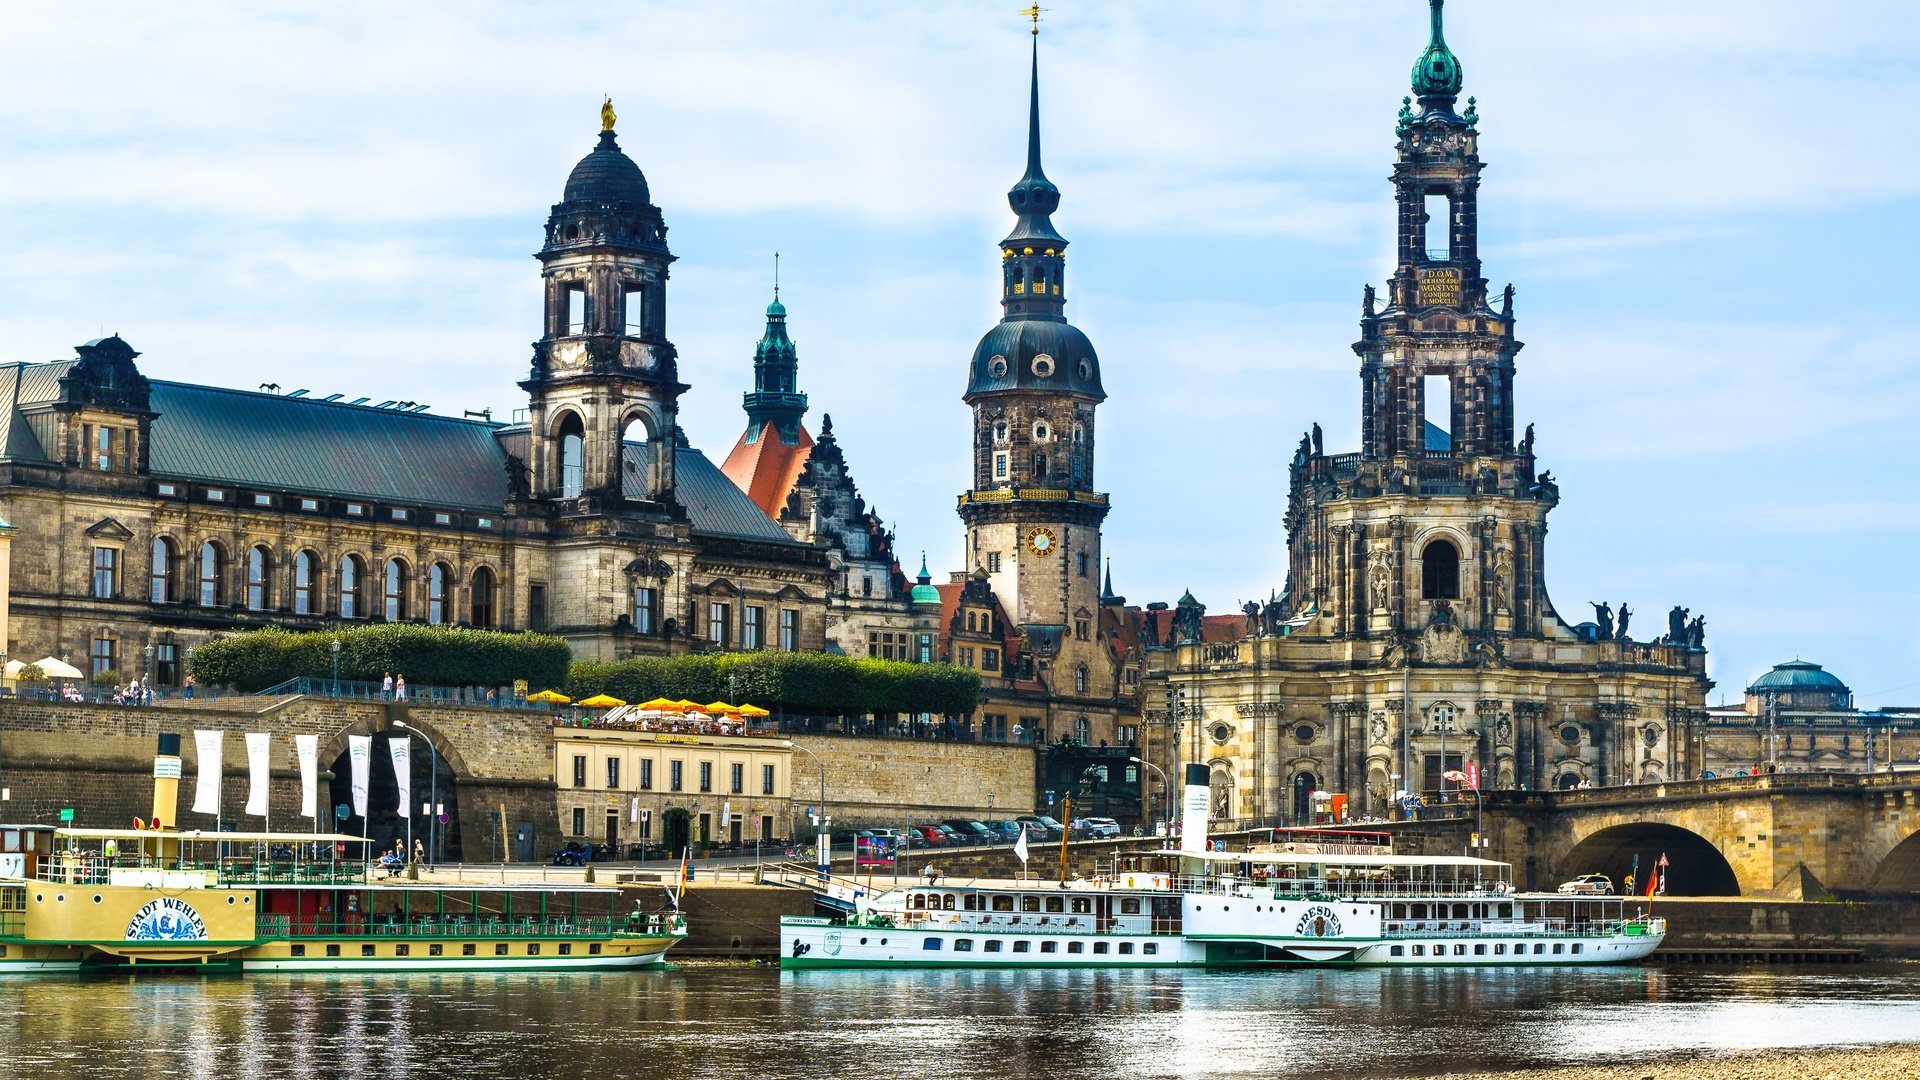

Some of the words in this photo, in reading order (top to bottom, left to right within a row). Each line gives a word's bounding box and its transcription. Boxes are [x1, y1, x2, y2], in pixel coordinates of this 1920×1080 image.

[1316, 844, 1373, 855] STADTRUNDFAHRT
[127, 900, 158, 938] STADT
[163, 898, 207, 938] WEHLEN
[1296, 905, 1344, 935] DRESDEN
